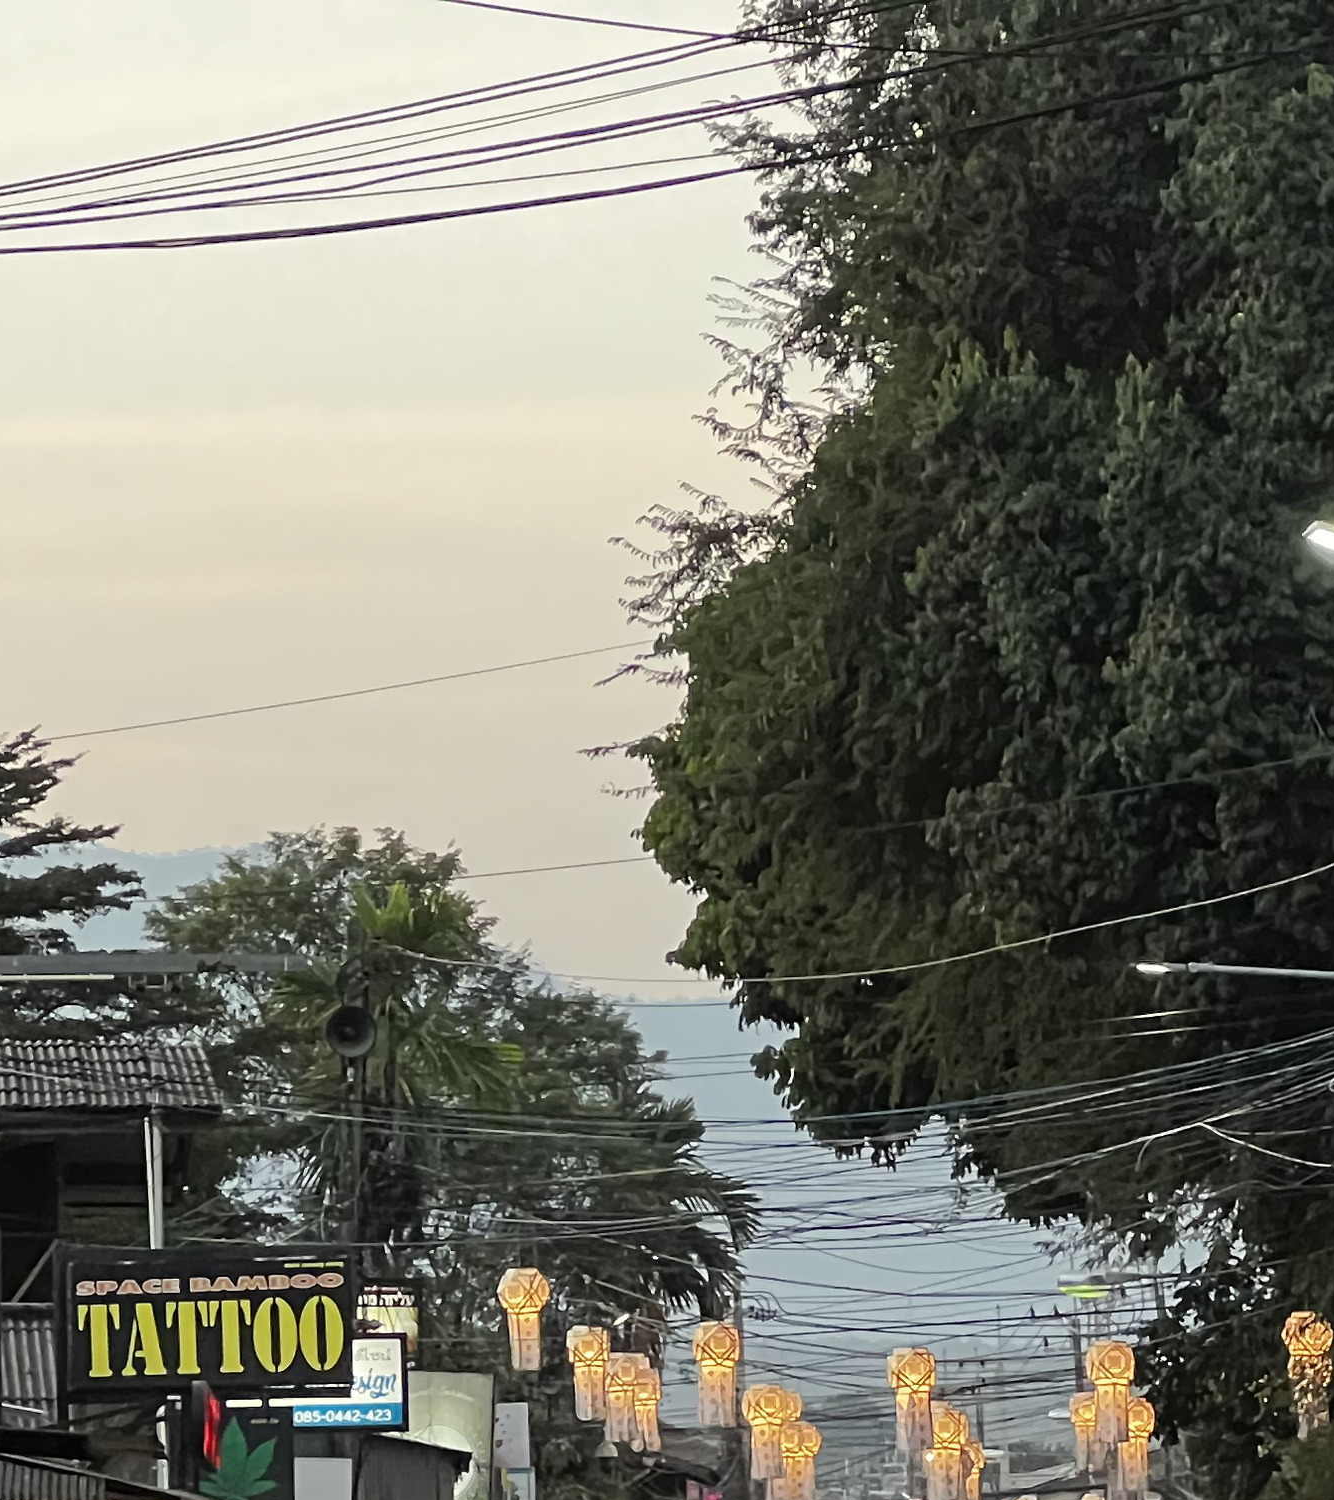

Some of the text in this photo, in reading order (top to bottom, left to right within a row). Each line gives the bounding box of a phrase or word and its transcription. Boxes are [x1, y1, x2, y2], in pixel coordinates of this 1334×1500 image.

[75, 1271, 345, 1296] SPACE BAMBOO
[77, 1295, 345, 1378] TATTOO
[352, 1367, 397, 1399] esign
[293, 1408, 393, 1425] 085-0442-423
